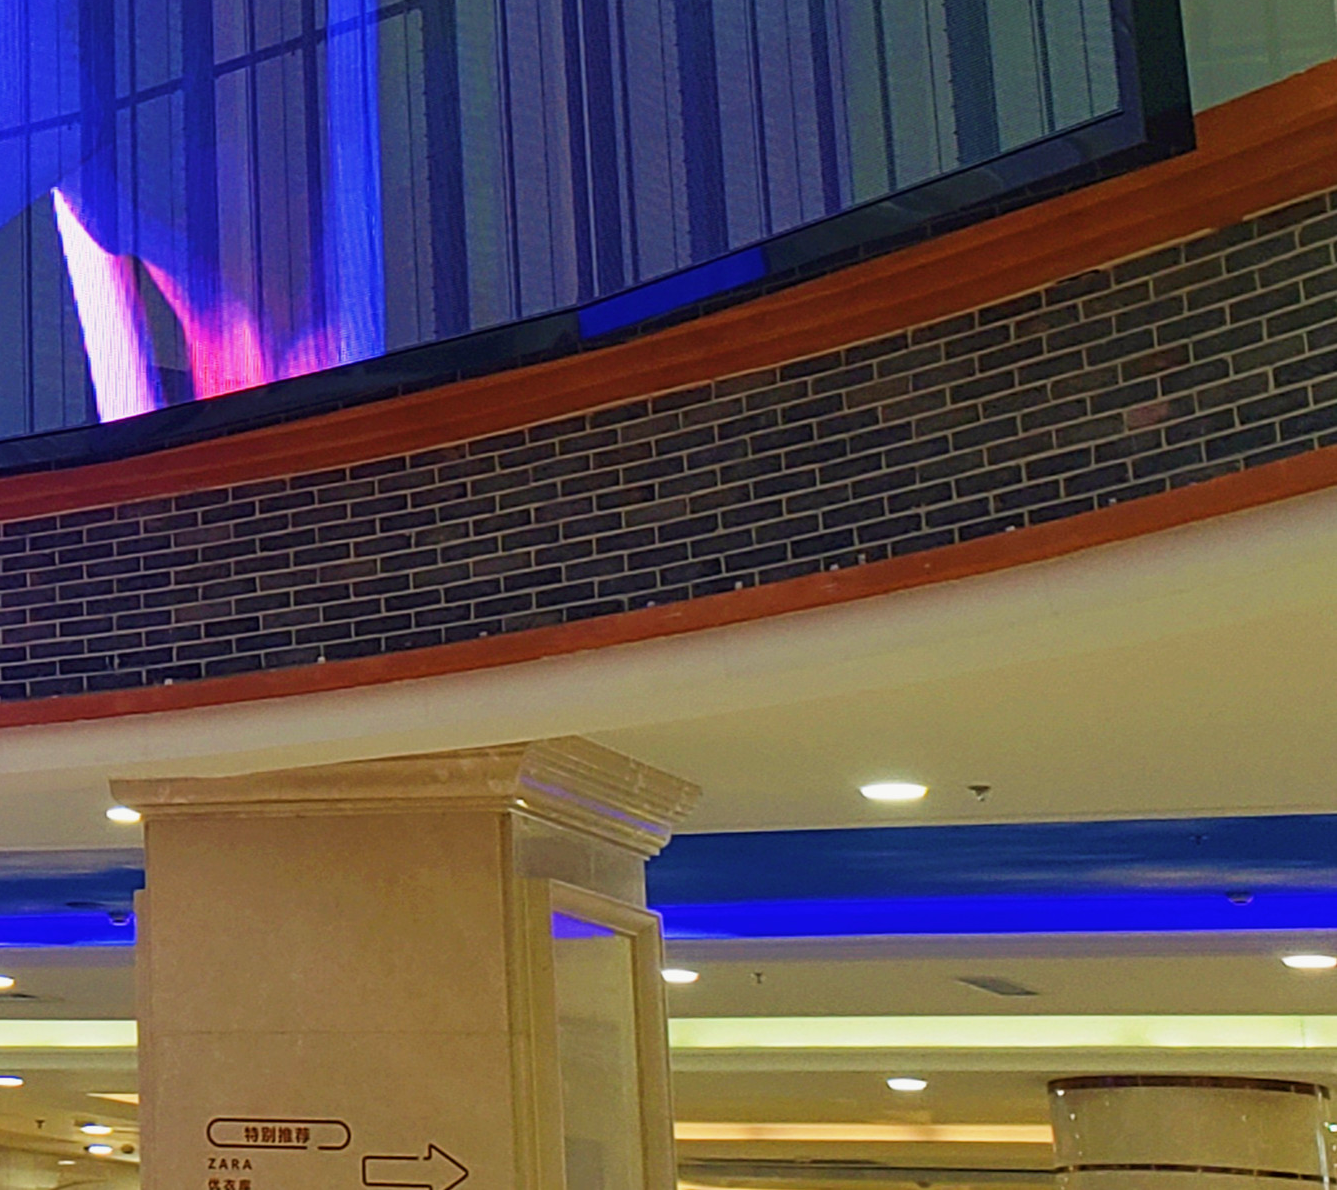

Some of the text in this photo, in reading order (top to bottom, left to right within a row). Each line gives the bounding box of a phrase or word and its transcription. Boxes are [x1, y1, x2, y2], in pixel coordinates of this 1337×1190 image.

[244, 1125, 311, 1144] 特别推荐
[207, 1157, 252, 1170] ZARA
